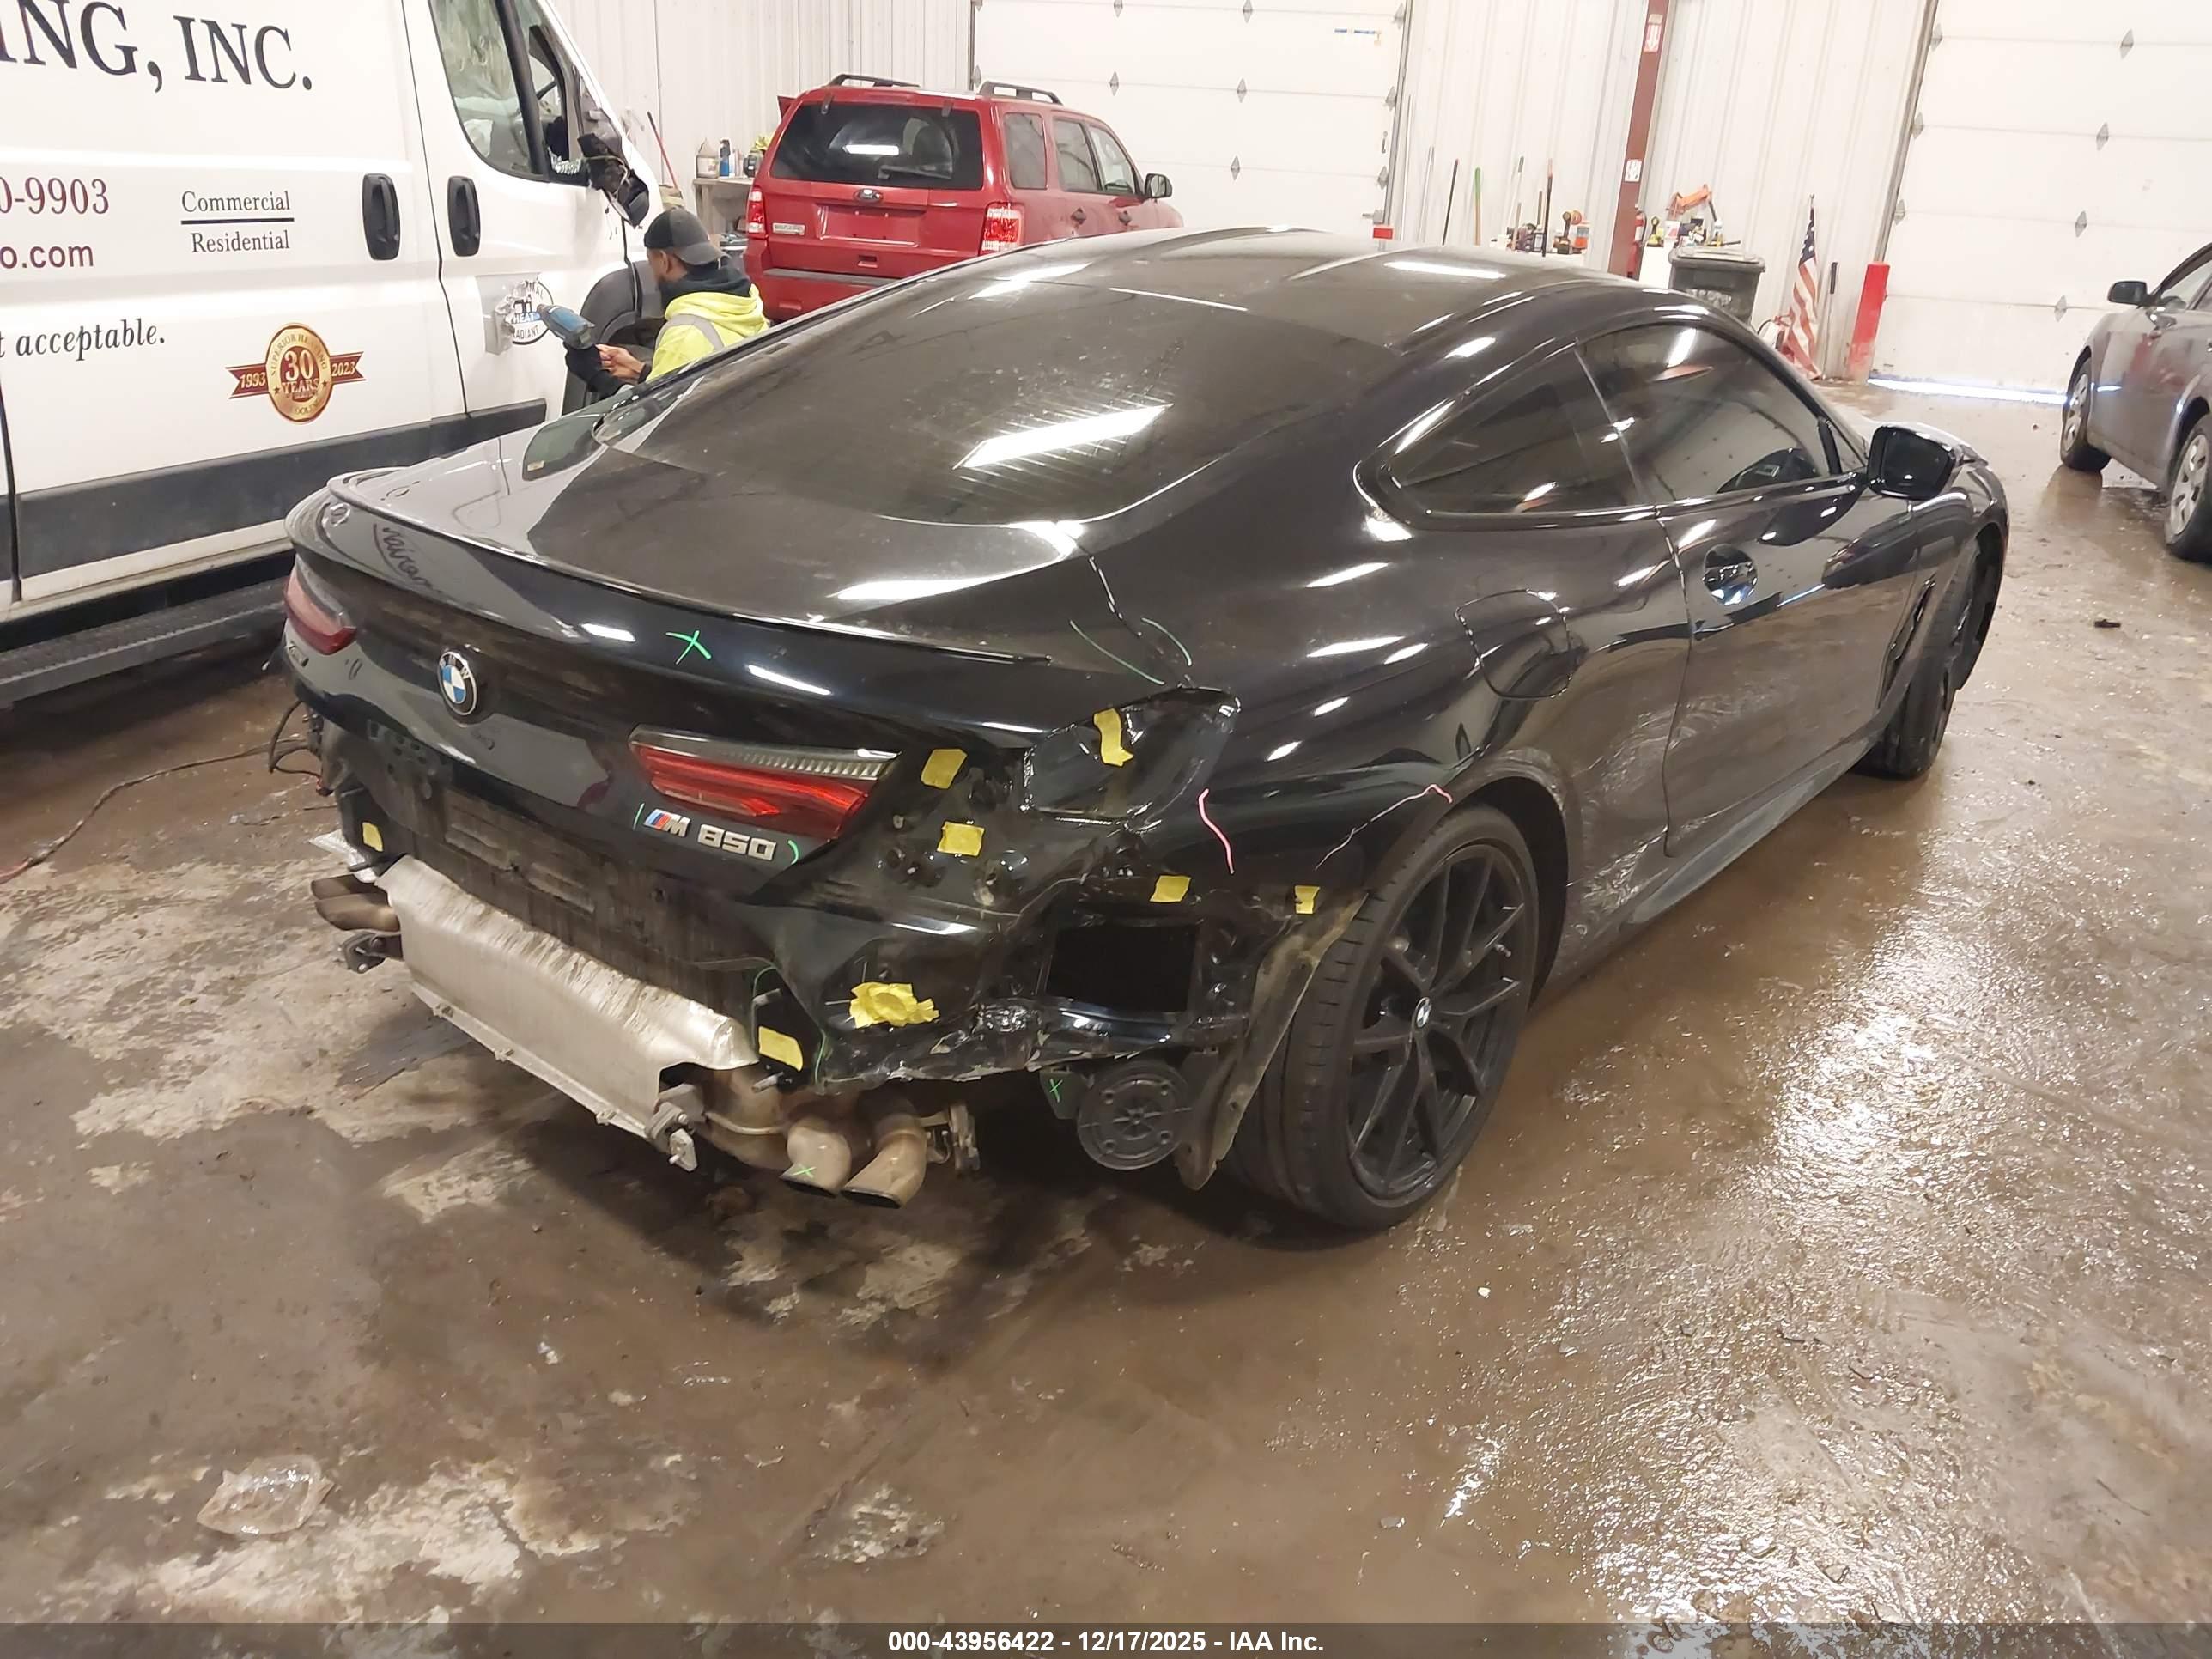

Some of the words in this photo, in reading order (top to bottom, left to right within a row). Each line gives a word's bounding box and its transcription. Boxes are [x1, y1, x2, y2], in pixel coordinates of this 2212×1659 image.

[173, 15, 312, 90] INC.
[0, 176, 109, 215] 0-9903
[181, 190, 291, 213] Commercial
[191, 229, 290, 253] Residential
[0, 246, 94, 269] o.com
[514, 313, 535, 324] HEAT
[15, 318, 165, 362] acceptable.
[514, 325, 539, 339] ADIANT
[271, 334, 297, 375] SUPERIOR
[284, 349, 314, 381] 30
[240, 371, 266, 389] 1993
[331, 361, 356, 377] 2023
[282, 378, 320, 393] YEARS
[655, 811, 690, 837] M
[697, 823, 776, 861] 850
